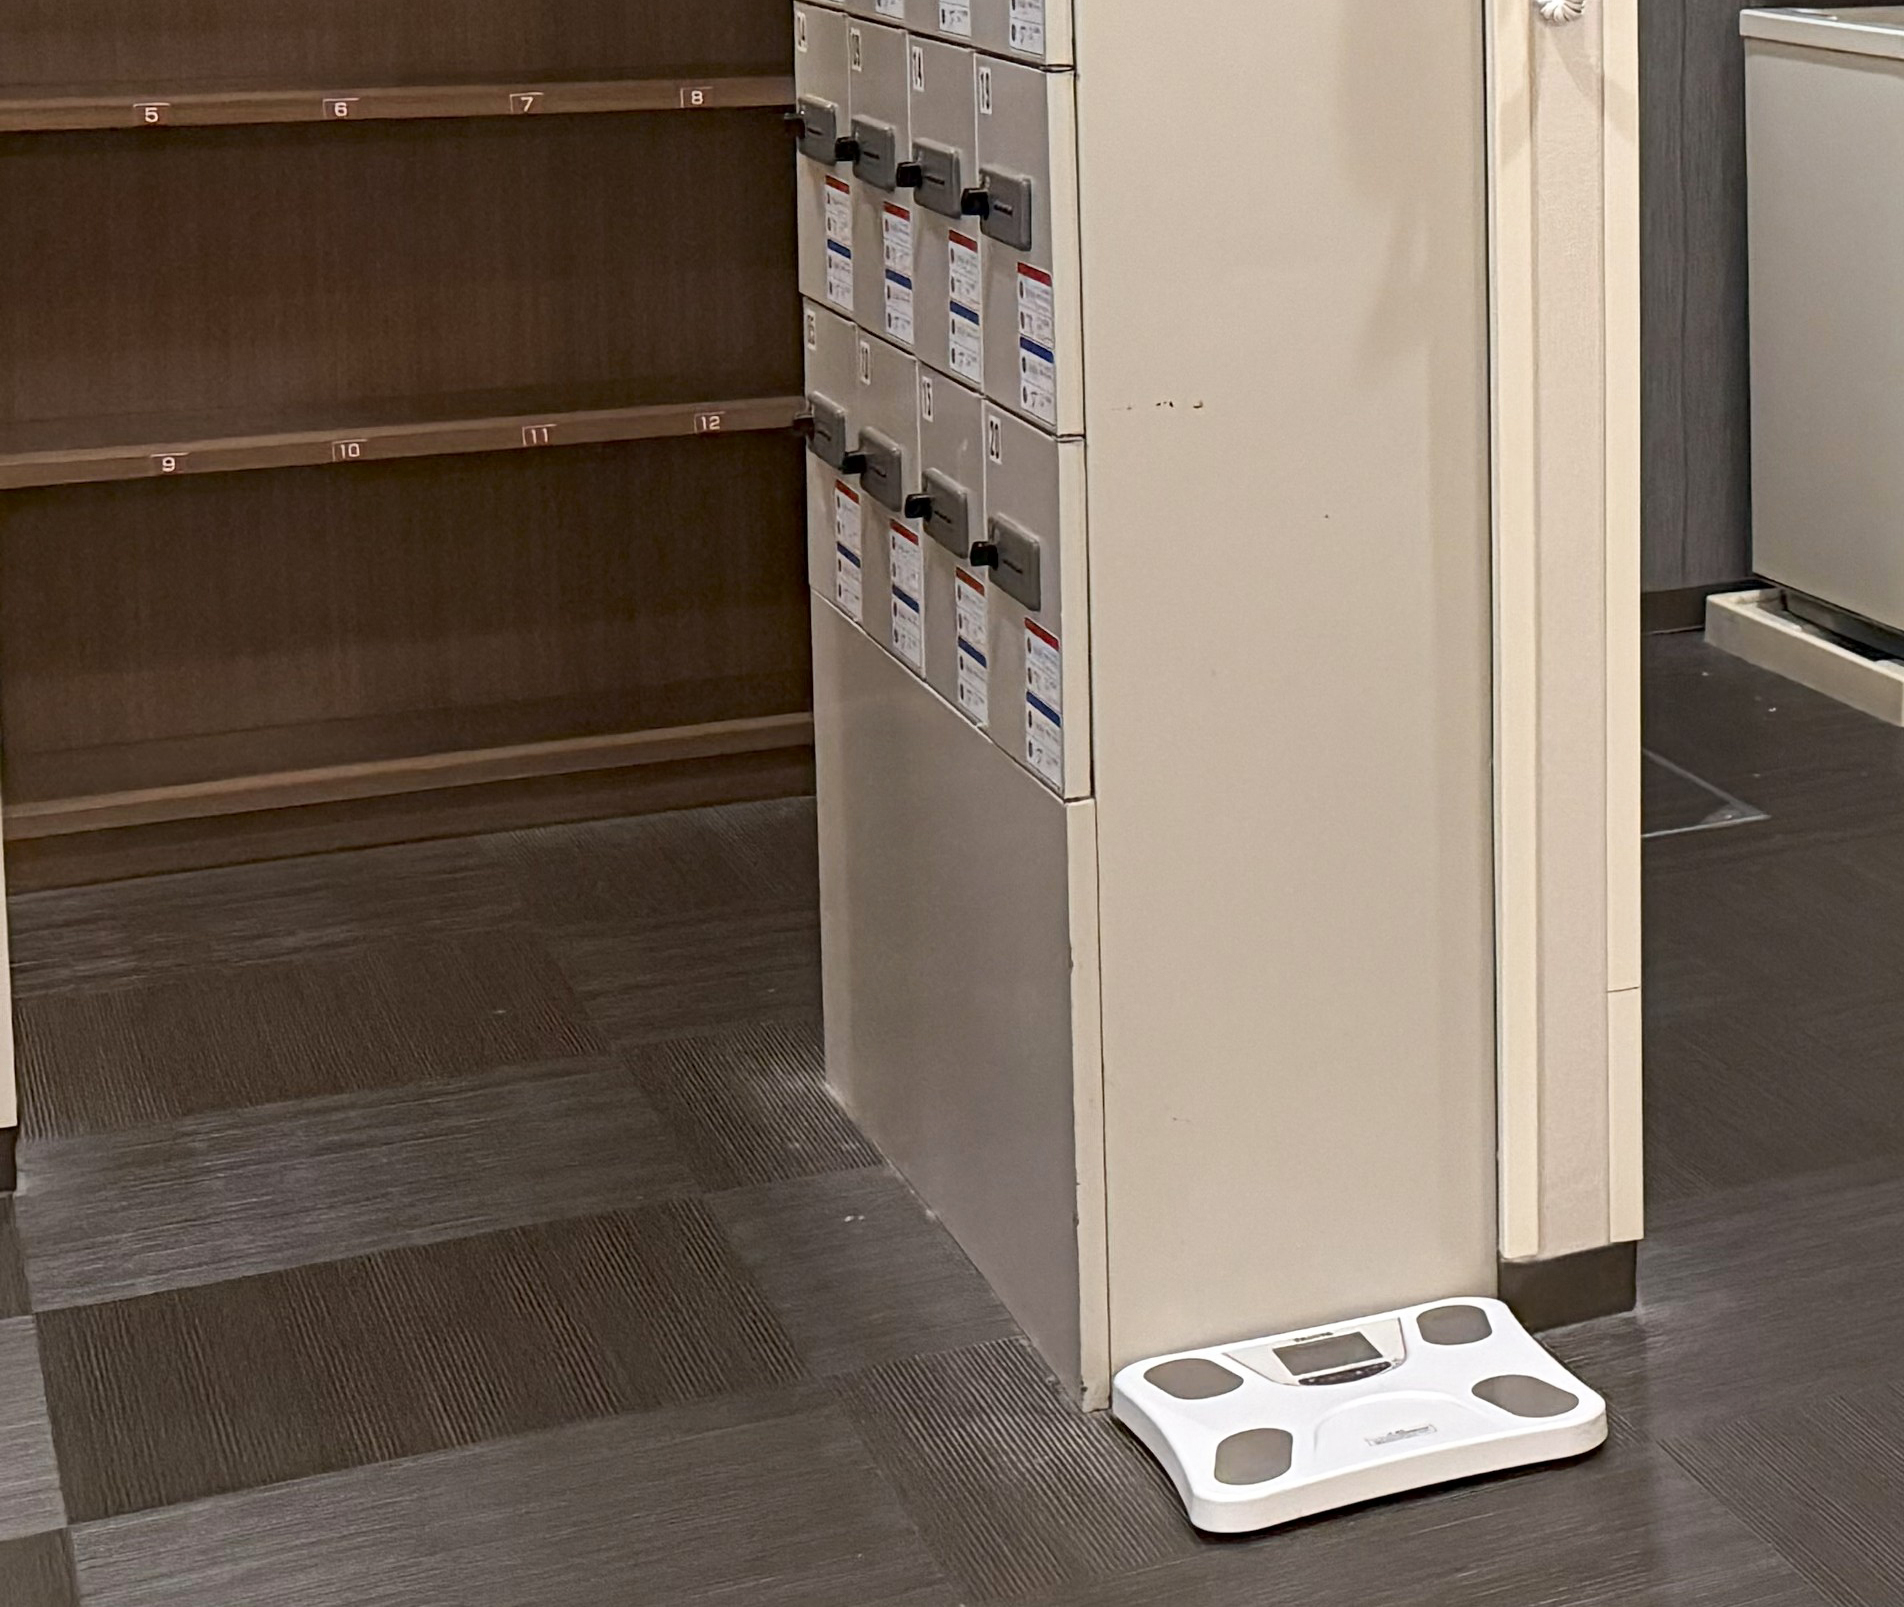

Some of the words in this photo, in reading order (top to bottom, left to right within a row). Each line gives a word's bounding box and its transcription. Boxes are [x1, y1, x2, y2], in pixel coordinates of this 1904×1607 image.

[521, 97, 534, 112] 7
[692, 91, 703, 105] 8
[145, 108, 158, 123] 5
[334, 102, 347, 116] 6
[701, 416, 721, 430] 12
[532, 428, 549, 443] 11
[339, 443, 360, 458] 10
[161, 457, 175, 472] 9
